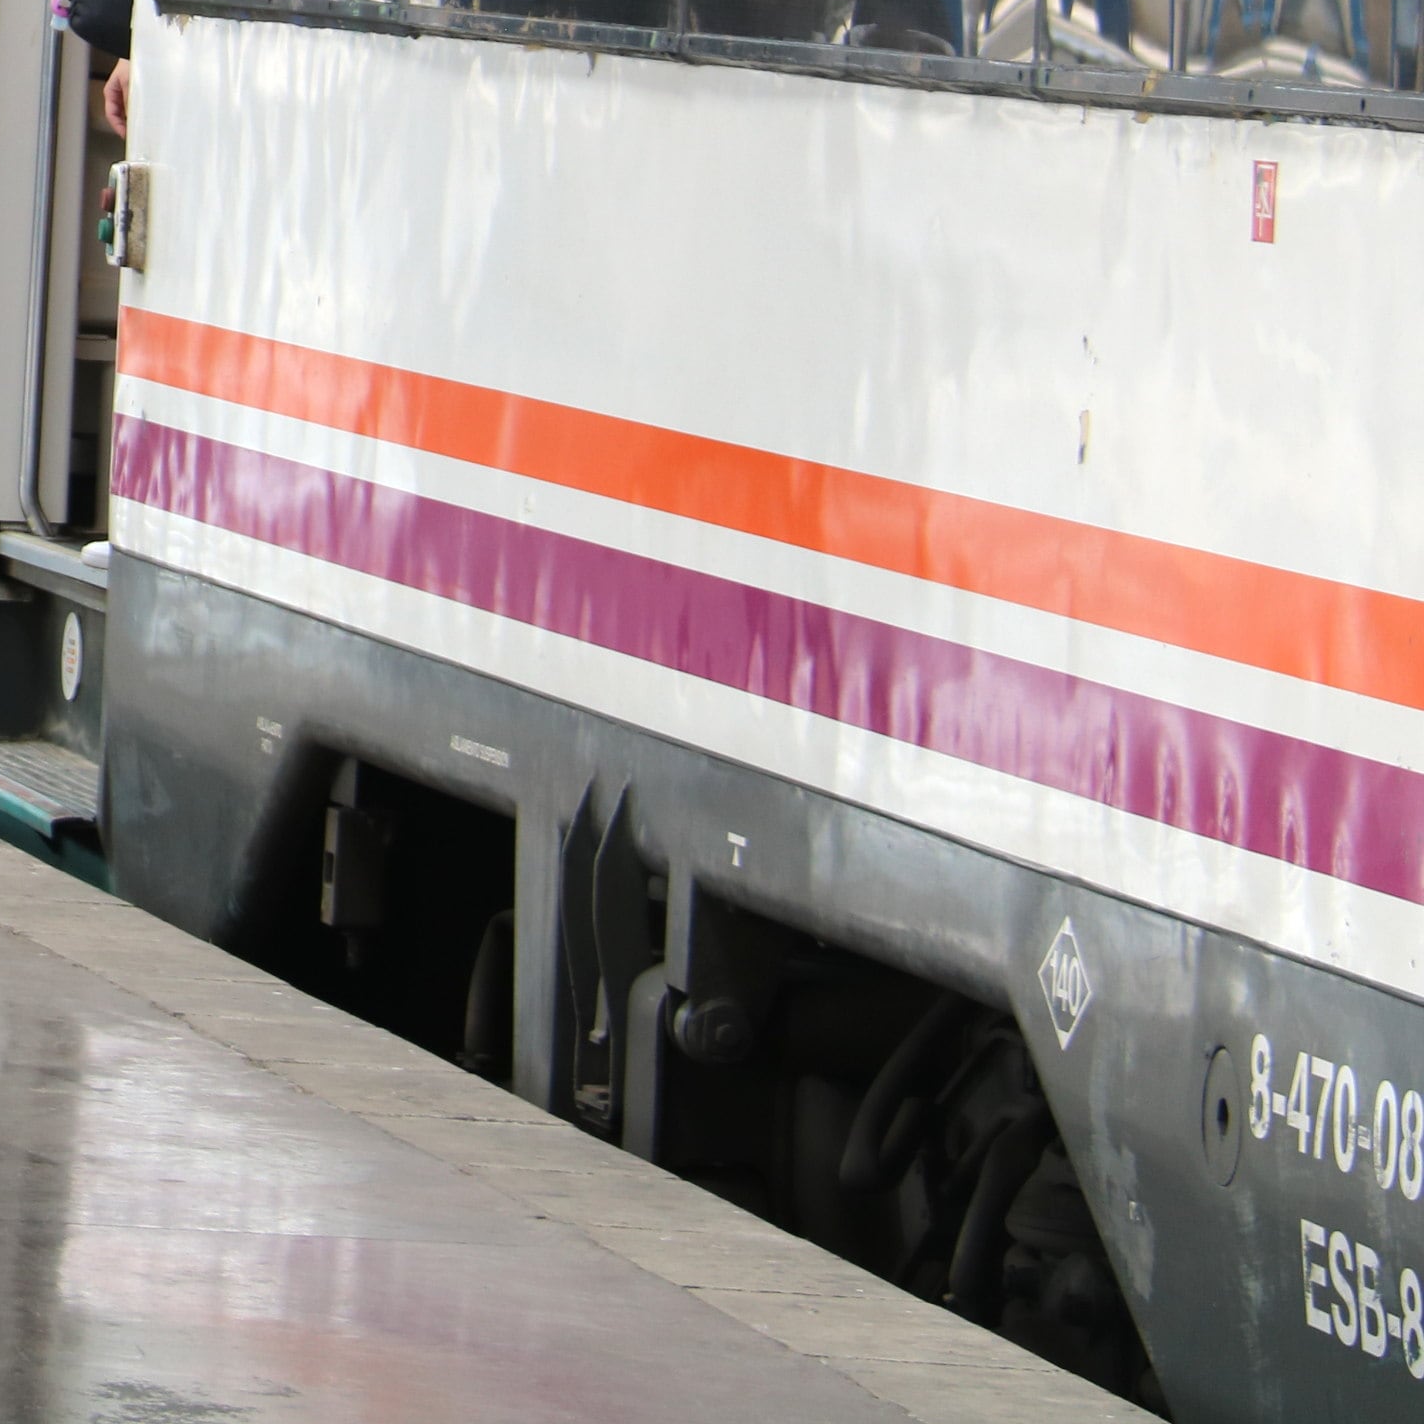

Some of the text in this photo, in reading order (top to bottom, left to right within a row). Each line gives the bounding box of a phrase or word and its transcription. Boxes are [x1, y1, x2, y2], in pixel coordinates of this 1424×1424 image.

[1049, 949, 1081, 1017] 140
[1249, 1033, 1424, 1202] 8-470-08
[1300, 1218, 1424, 1380] ESB-8
